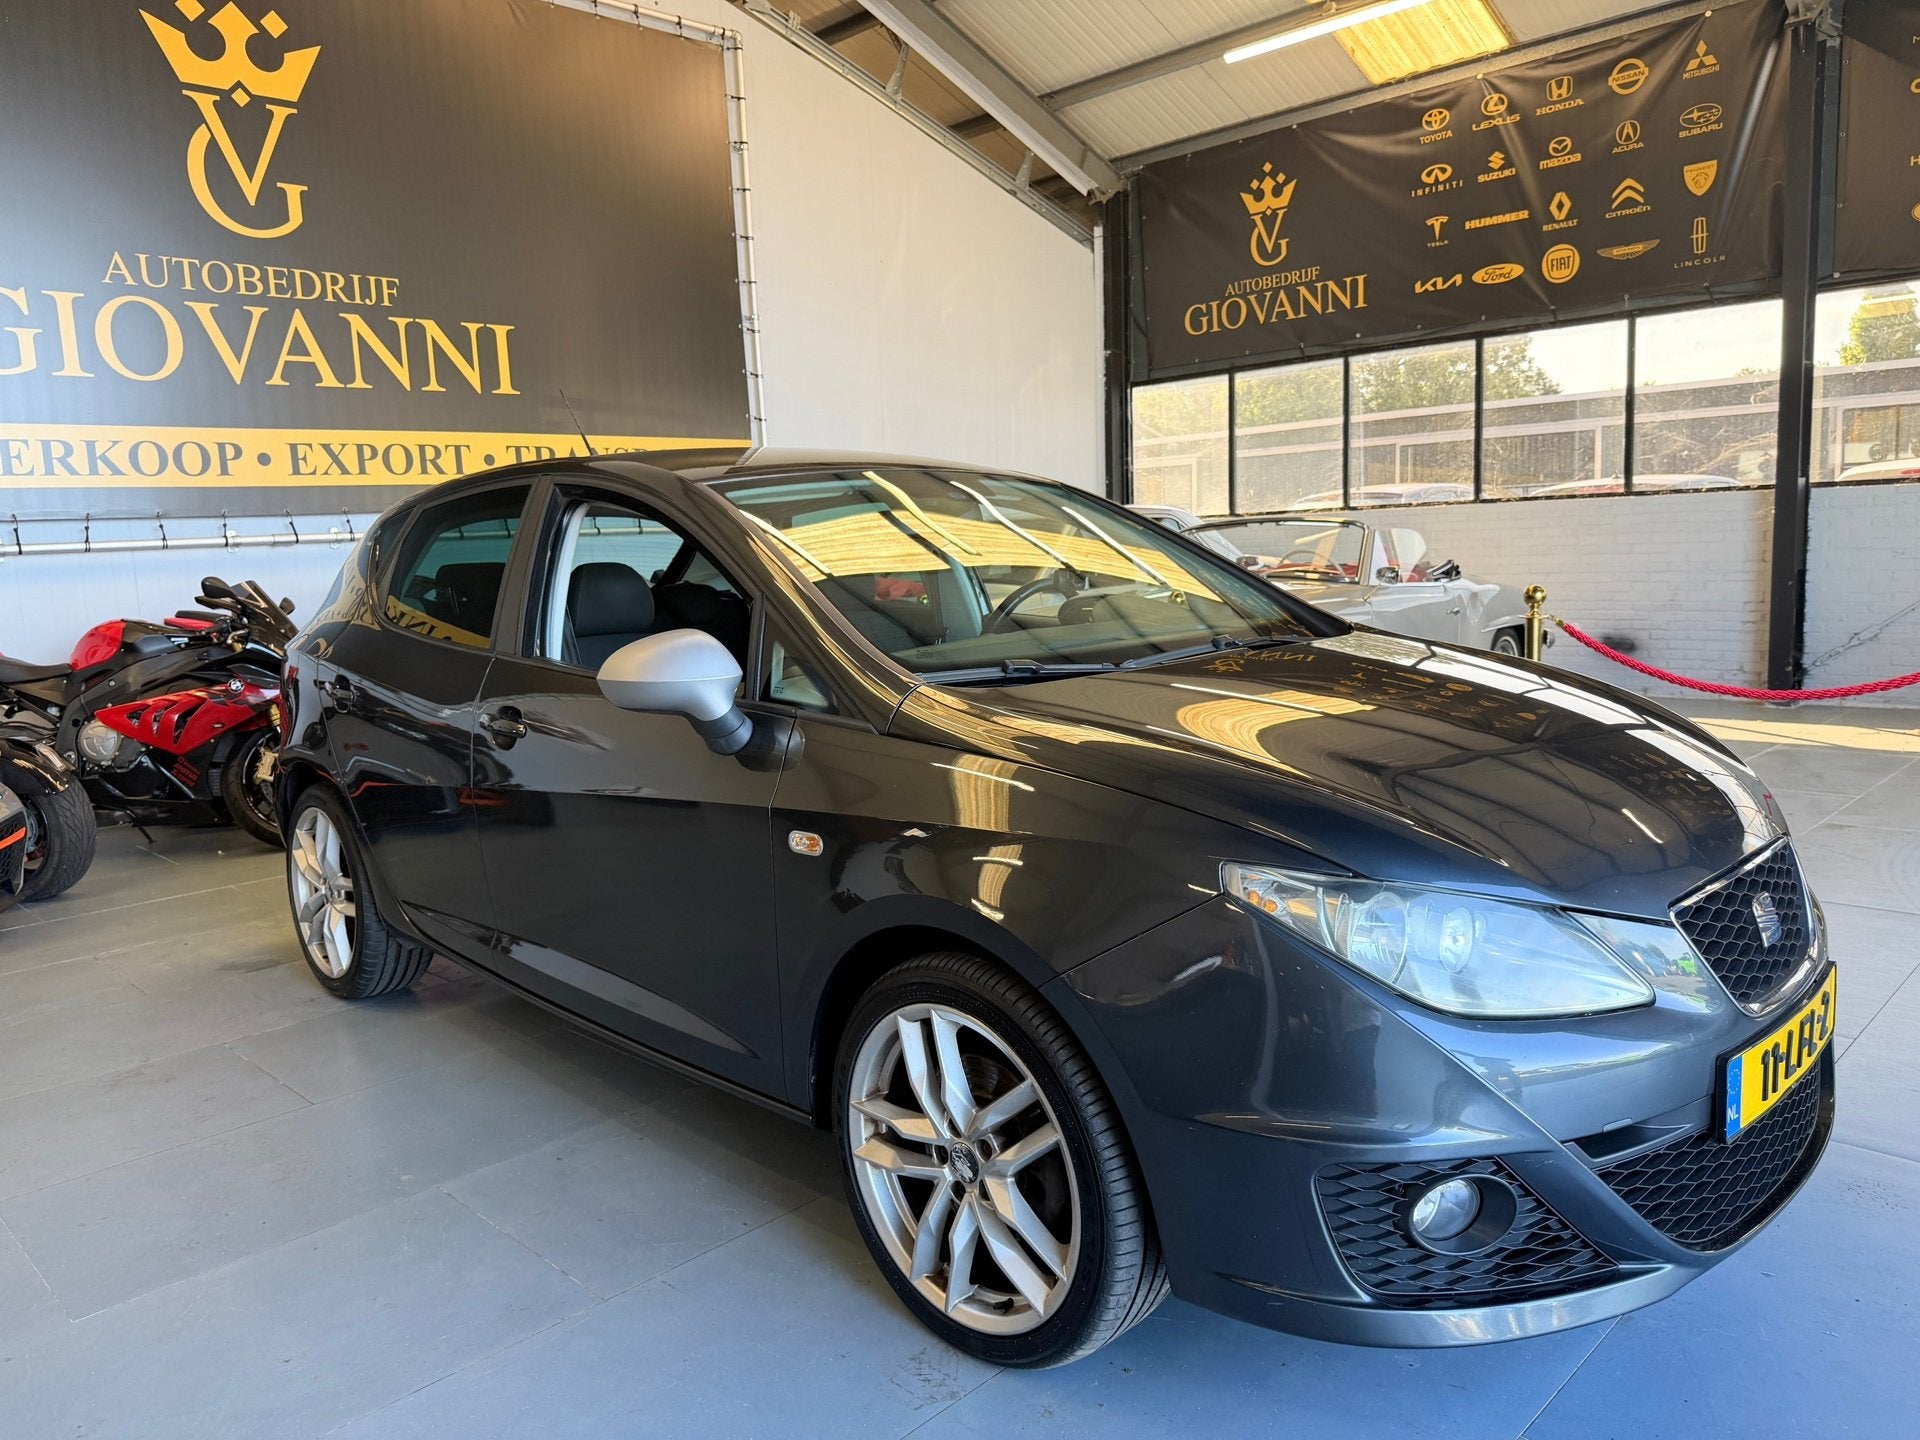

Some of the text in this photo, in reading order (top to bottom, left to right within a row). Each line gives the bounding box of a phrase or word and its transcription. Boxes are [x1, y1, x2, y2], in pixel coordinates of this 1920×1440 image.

[1611, 69, 1646, 83] NISSAN
[1683, 64, 1720, 80] MITSUBISHI
[1535, 98, 1585, 116] HONDA
[1471, 113, 1521, 131] LEXUS
[1678, 122, 1723, 138] SUBARU
[1419, 129, 1453, 144] TOYOTA
[1611, 141, 1645, 154] ACURA
[1477, 167, 1516, 183] SUZUKI
[1411, 179, 1464, 198] INFINITI
[1464, 209, 1531, 230] HUMMER
[1542, 218, 1579, 232] RENAULT
[1550, 255, 1572, 273] FIAT
[1674, 254, 1727, 269] LINCOLN
[101, 250, 400, 307] AUTOBEDRIJF
[1224, 266, 1321, 297] AUTOBEDRIJF
[1481, 266, 1513, 283] Ford
[1184, 273, 1369, 336] GIOVANNI
[285, 442, 471, 477] EXPORT
[1761, 990, 1830, 1102] 11-LFL-2
[1727, 1103, 1739, 1124] NL
